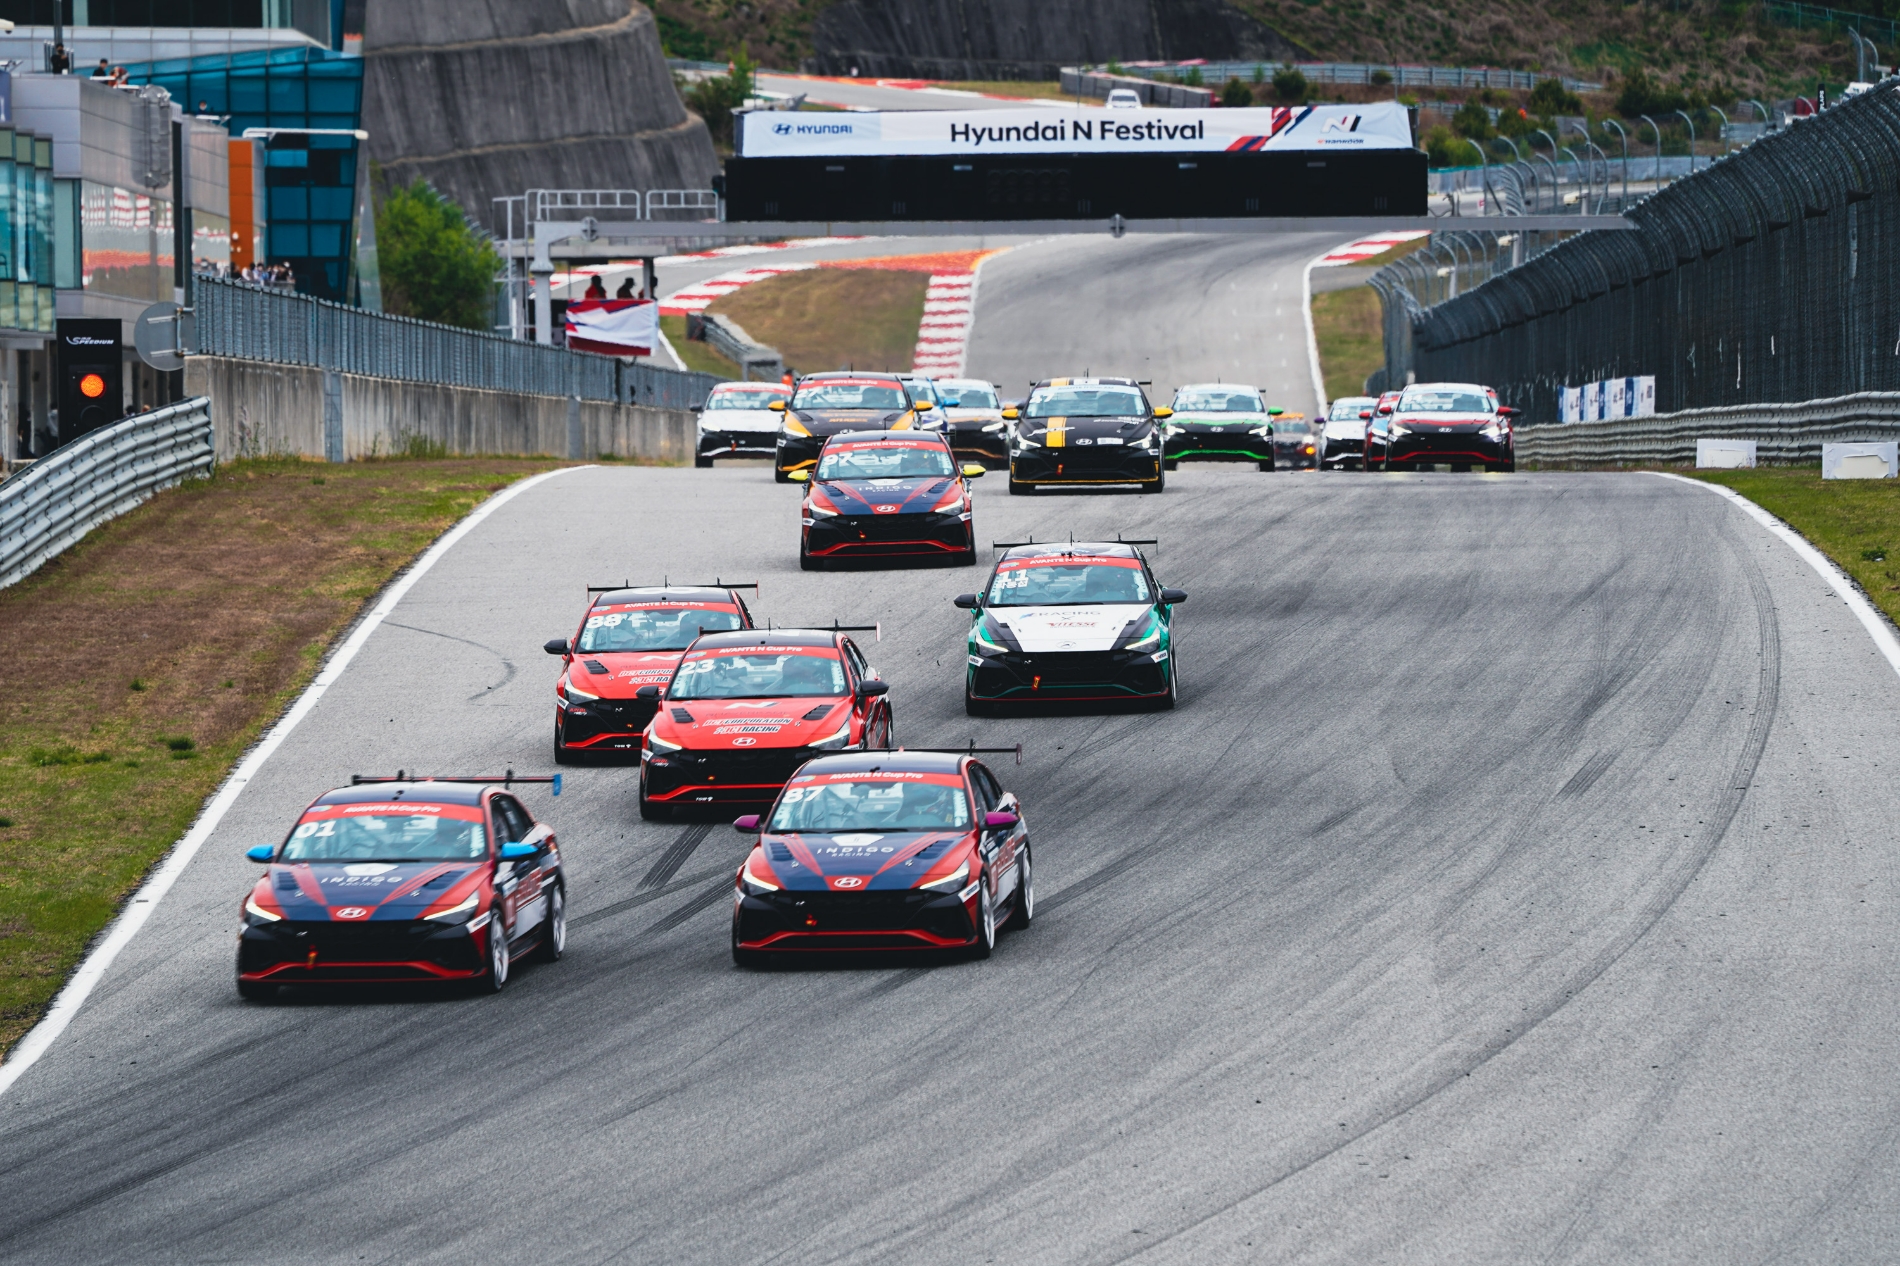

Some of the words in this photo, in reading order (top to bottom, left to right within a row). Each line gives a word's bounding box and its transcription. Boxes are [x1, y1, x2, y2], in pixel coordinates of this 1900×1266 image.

[797, 124, 853, 135] HYUNDAI
[950, 119, 1066, 146] Hyundai
[1072, 120, 1093, 141] N
[1100, 119, 1204, 140] Festival
[824, 452, 853, 466] 97
[1029, 557, 1064, 565] AVANTE
[999, 569, 1029, 583] 11
[585, 613, 622, 629] 88
[718, 646, 757, 654] AVANTE
[677, 659, 715, 676] 23
[829, 772, 873, 781] AVANTE
[882, 771, 904, 779] Cup
[781, 785, 827, 804] 87
[293, 819, 337, 839] 01
[817, 846, 895, 854] INDIGO
[320, 875, 403, 884] INDIGO
